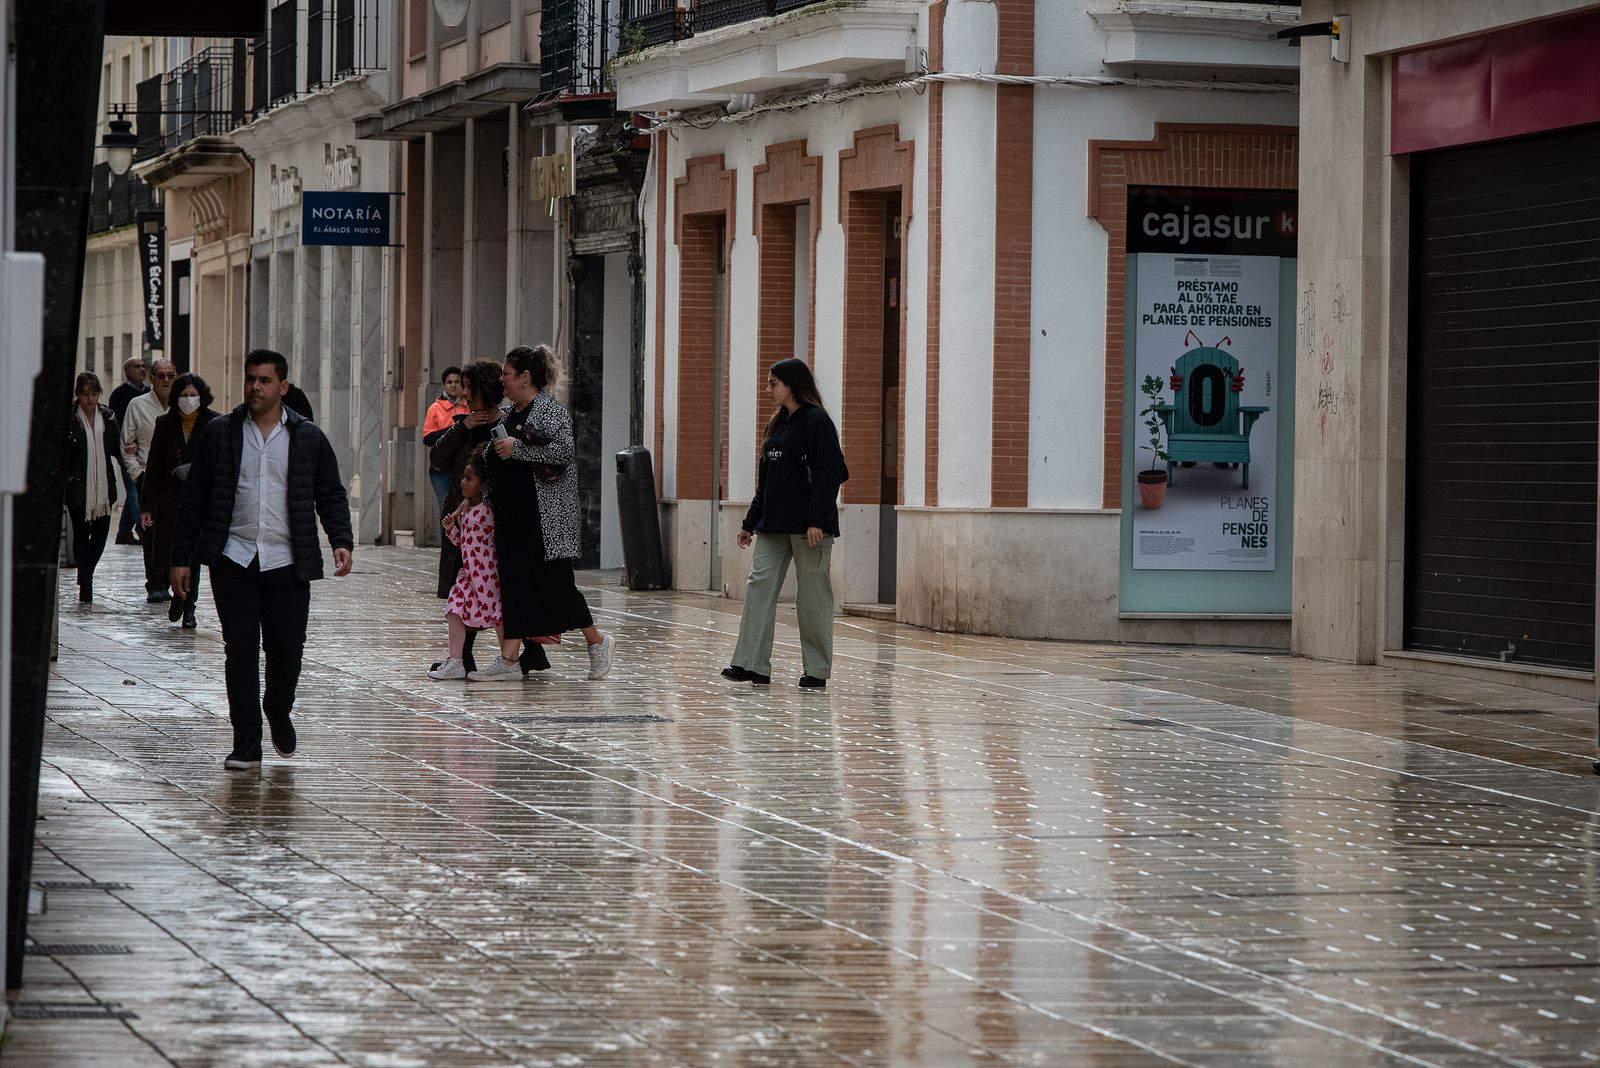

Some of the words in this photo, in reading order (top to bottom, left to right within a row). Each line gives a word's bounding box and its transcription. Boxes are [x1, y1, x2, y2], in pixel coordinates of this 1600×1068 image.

[312, 205, 382, 220] NOTARÍA
[323, 224, 351, 234] ÁBALOS
[354, 226, 381, 234] NUEVO
[1142, 205, 1271, 245] cajasur
[1281, 211, 1294, 232] k
[1177, 278, 1239, 293] PRÉSTAMO
[1178, 292, 1194, 303] AL
[1196, 292, 1213, 304] 0%
[1215, 293, 1238, 304] TAE
[1153, 303, 1184, 314] PARA
[1188, 303, 1243, 316] AHORRAR
[1246, 305, 1261, 316] EN
[1142, 314, 1188, 326] PLANES
[1190, 315, 1206, 326] DE
[1208, 316, 1272, 328] PENSIONES
[1220, 496, 1269, 510] PLANES
[1252, 510, 1269, 523] DE
[1222, 522, 1269, 536] PENSIO
[1241, 535, 1269, 549] NES
